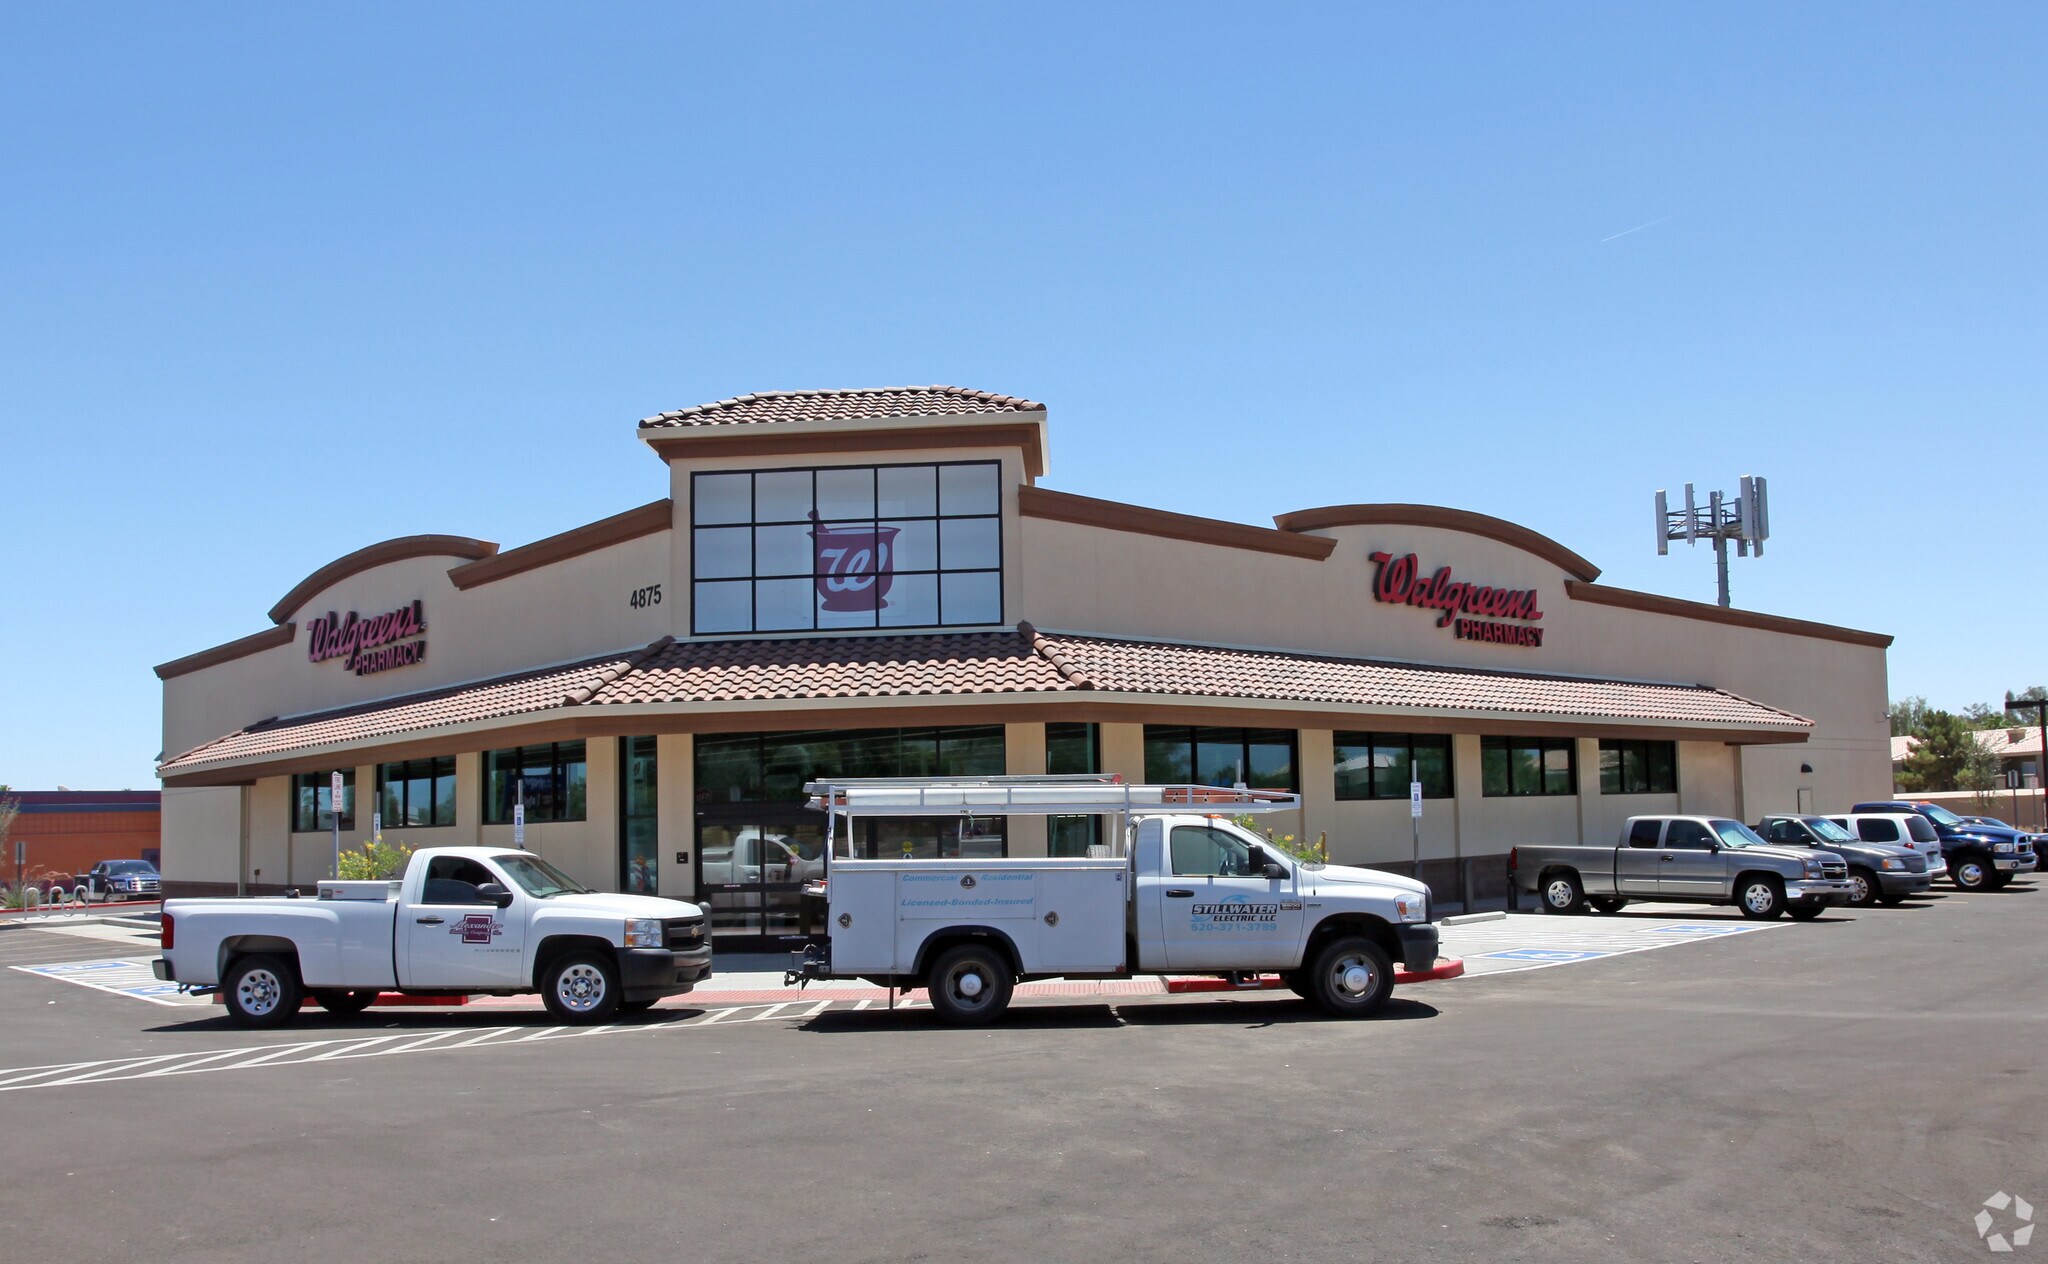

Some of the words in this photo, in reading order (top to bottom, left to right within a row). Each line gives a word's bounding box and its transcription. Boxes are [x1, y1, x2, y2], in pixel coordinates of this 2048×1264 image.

[630, 584, 662, 610] 4875
[1368, 551, 1544, 628] Walgreens
[306, 599, 424, 671] Walgreens
[1455, 618, 1545, 647] PHARMACY
[355, 640, 426, 676] PHARMACY
[981, 873, 1033, 881] Residential
[901, 897, 1033, 907] Licensed-Bonded-Insured
[1193, 904, 1277, 914] STILLWATER
